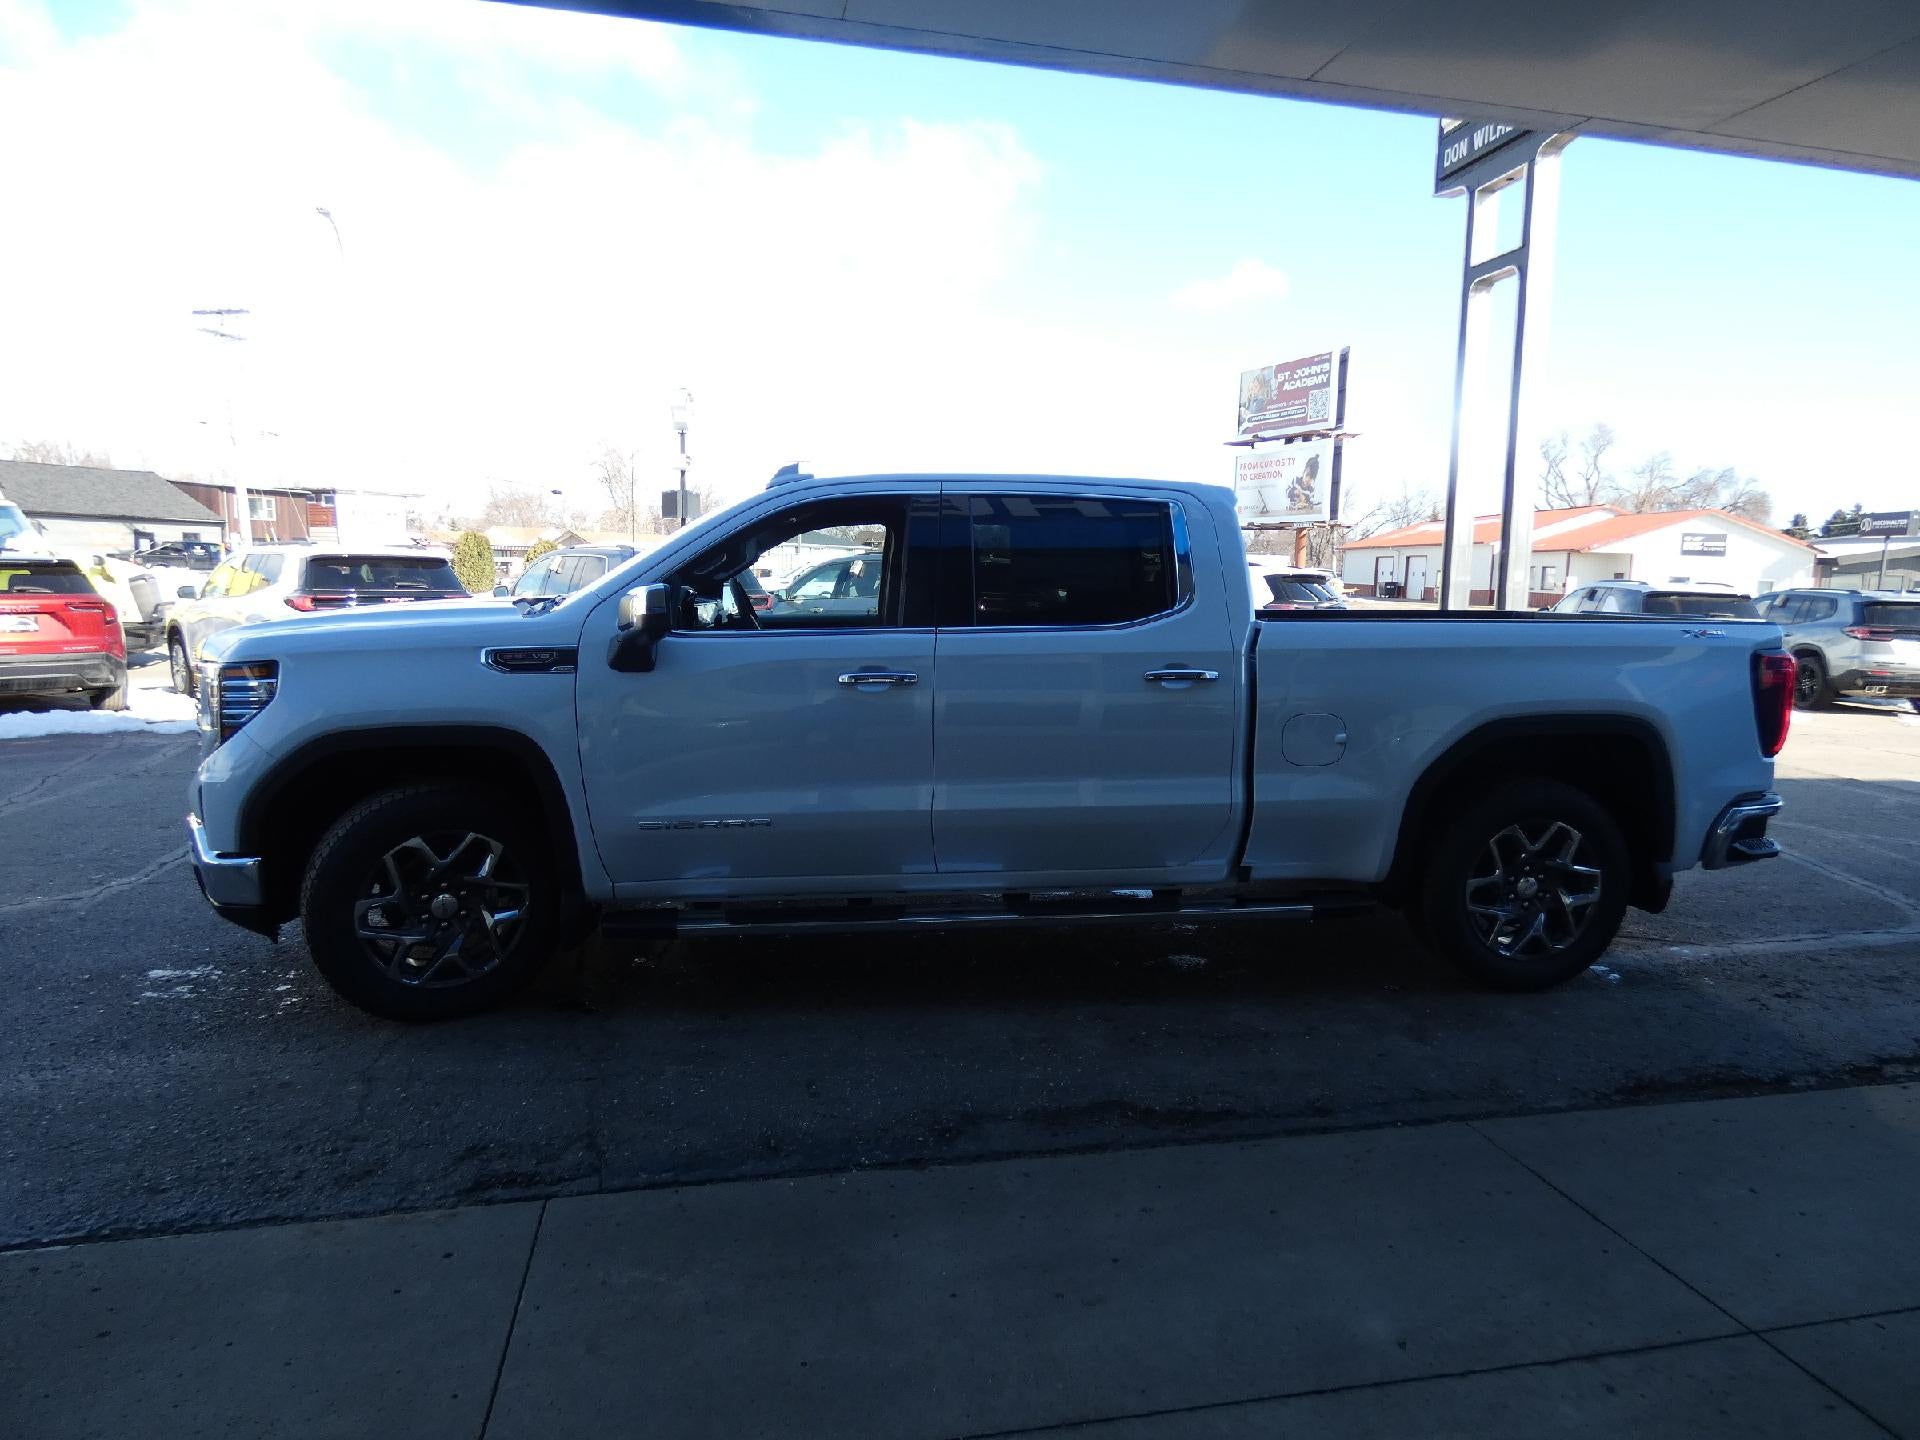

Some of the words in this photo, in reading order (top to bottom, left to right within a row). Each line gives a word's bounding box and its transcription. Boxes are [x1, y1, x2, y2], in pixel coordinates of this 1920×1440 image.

[1443, 137, 1468, 168] DON
[1473, 124, 1514, 151] WIL
[1277, 371, 1292, 382] ST.
[1293, 362, 1330, 377] JOHN'S
[1282, 374, 1329, 391] ACADEMY
